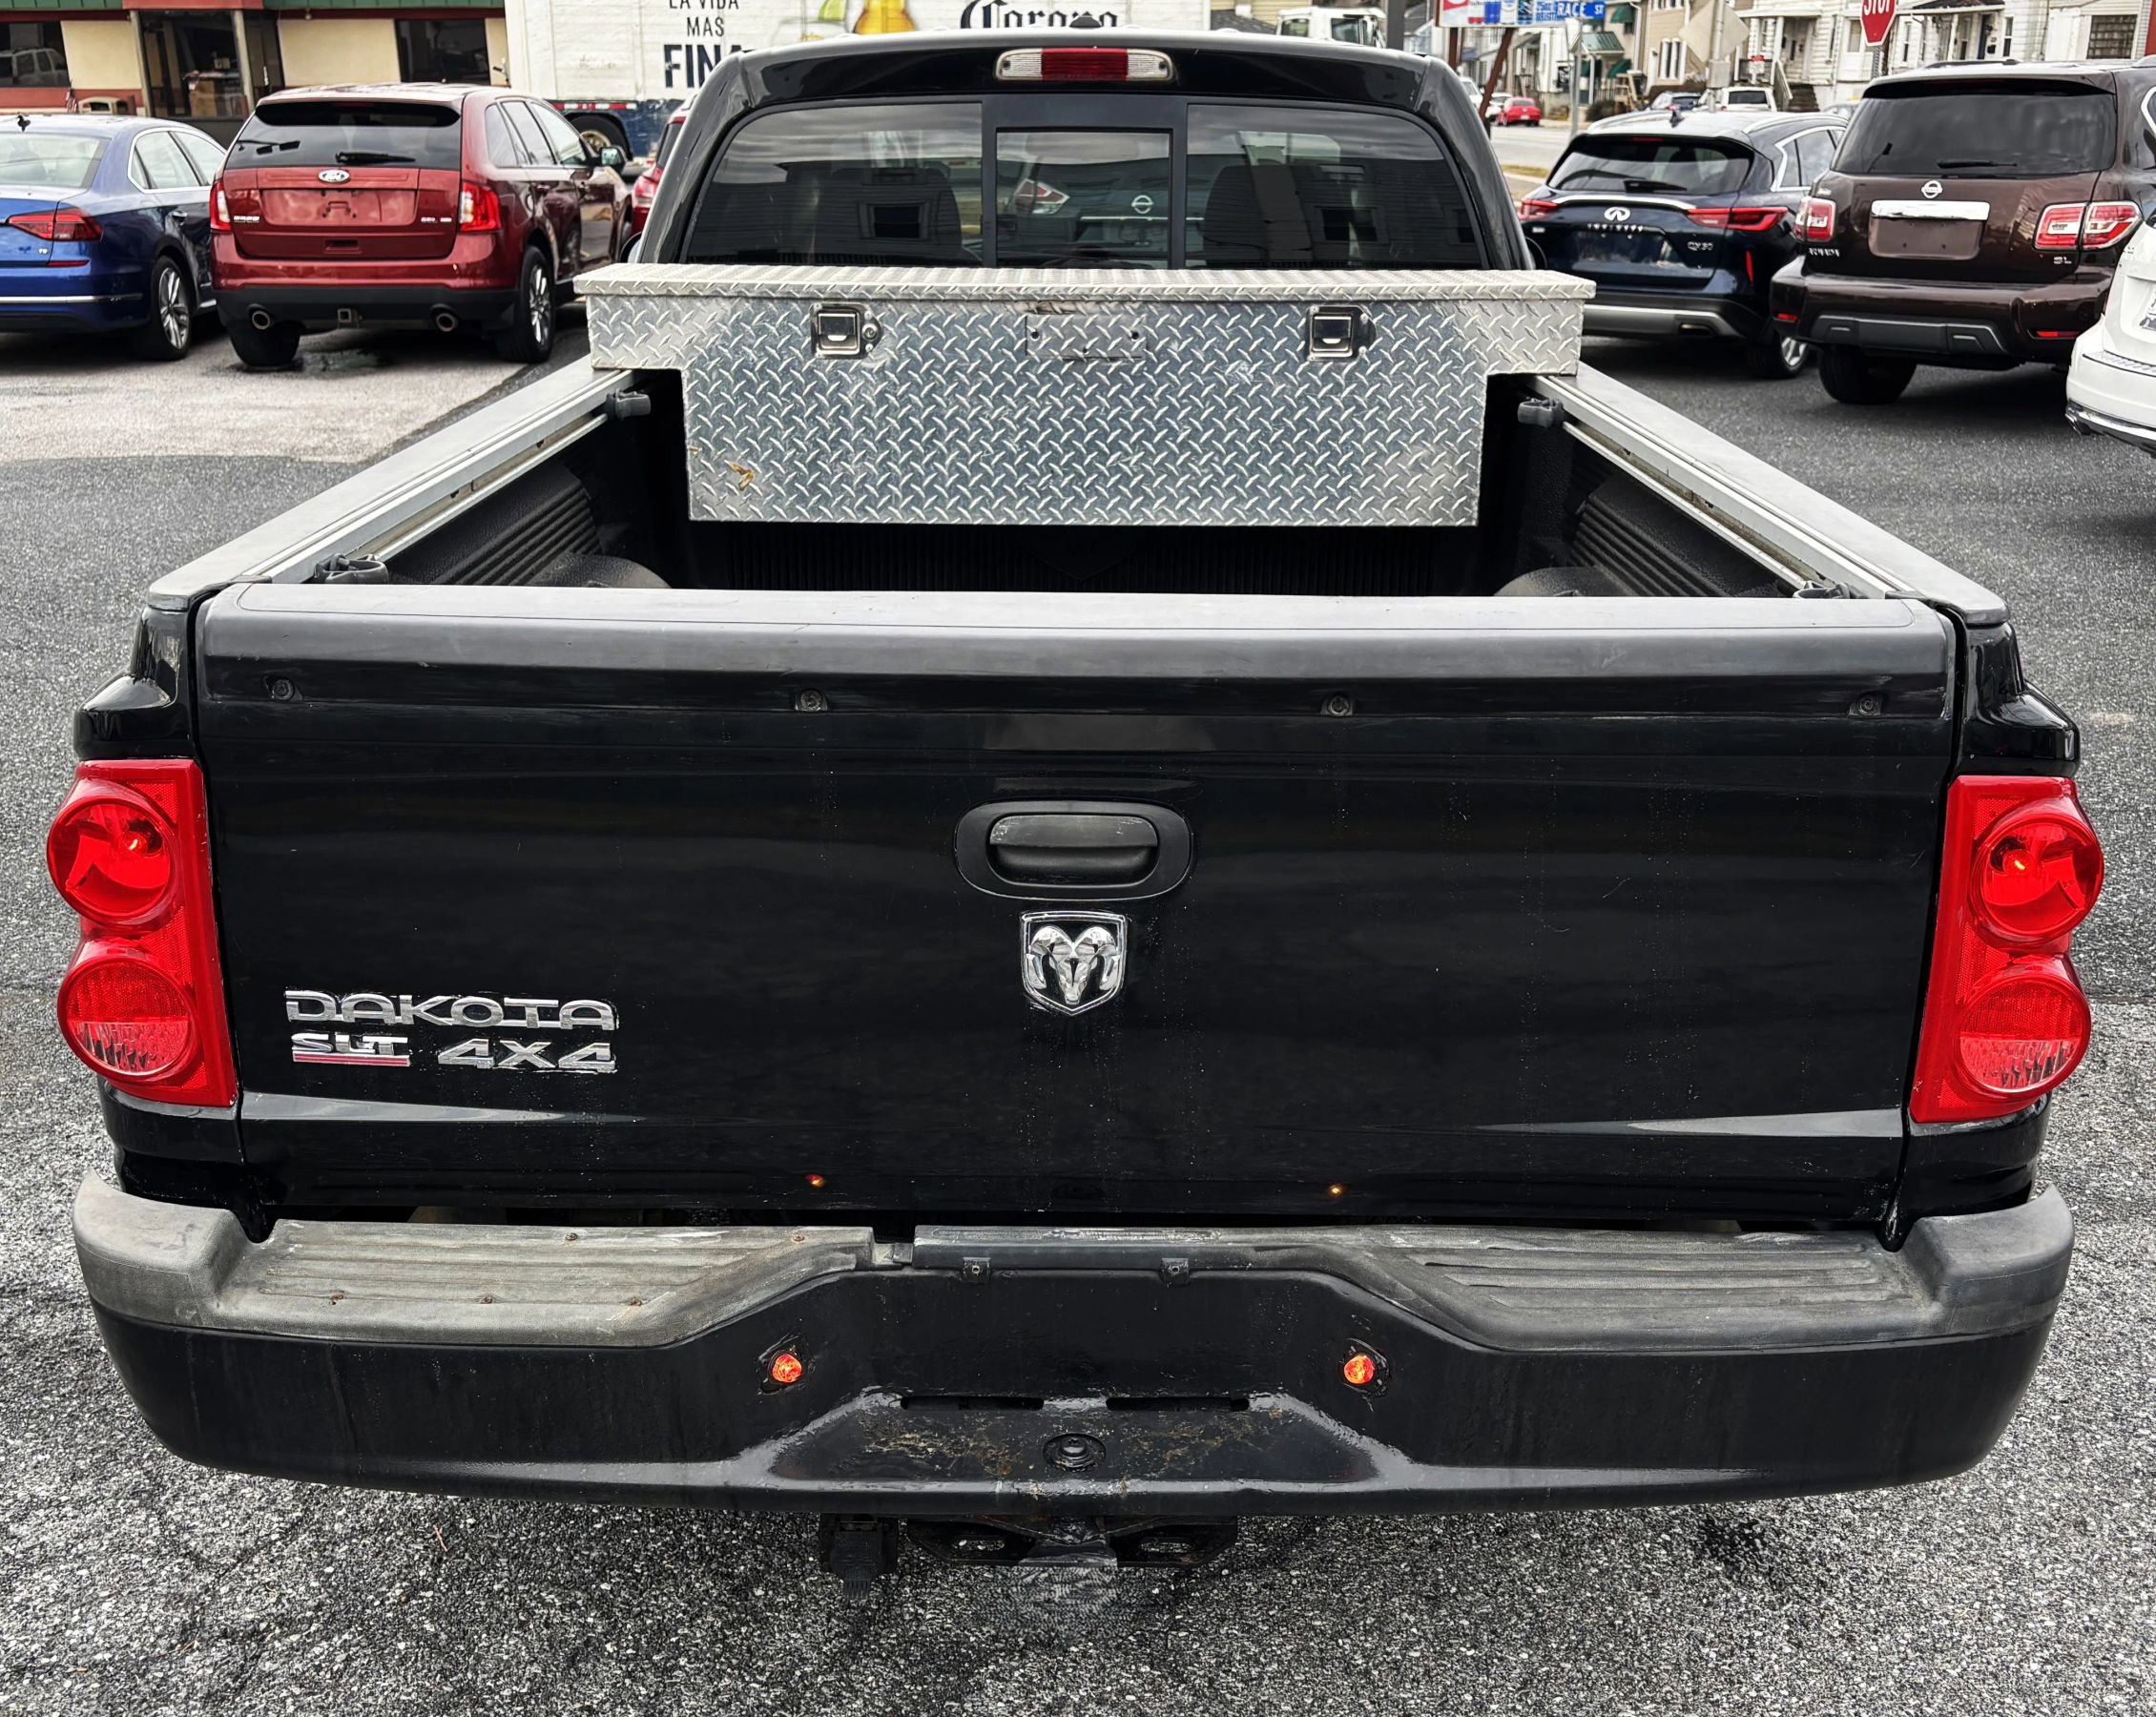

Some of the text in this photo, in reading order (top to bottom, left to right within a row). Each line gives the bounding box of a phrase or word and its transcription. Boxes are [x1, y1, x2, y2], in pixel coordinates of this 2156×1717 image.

[1557, 2, 1586, 16] RACE
[686, 16, 724, 37] MAS
[663, 44, 742, 88] FIN
[285, 989, 618, 1031] DAKOTA
[291, 1032, 411, 1056] SLT
